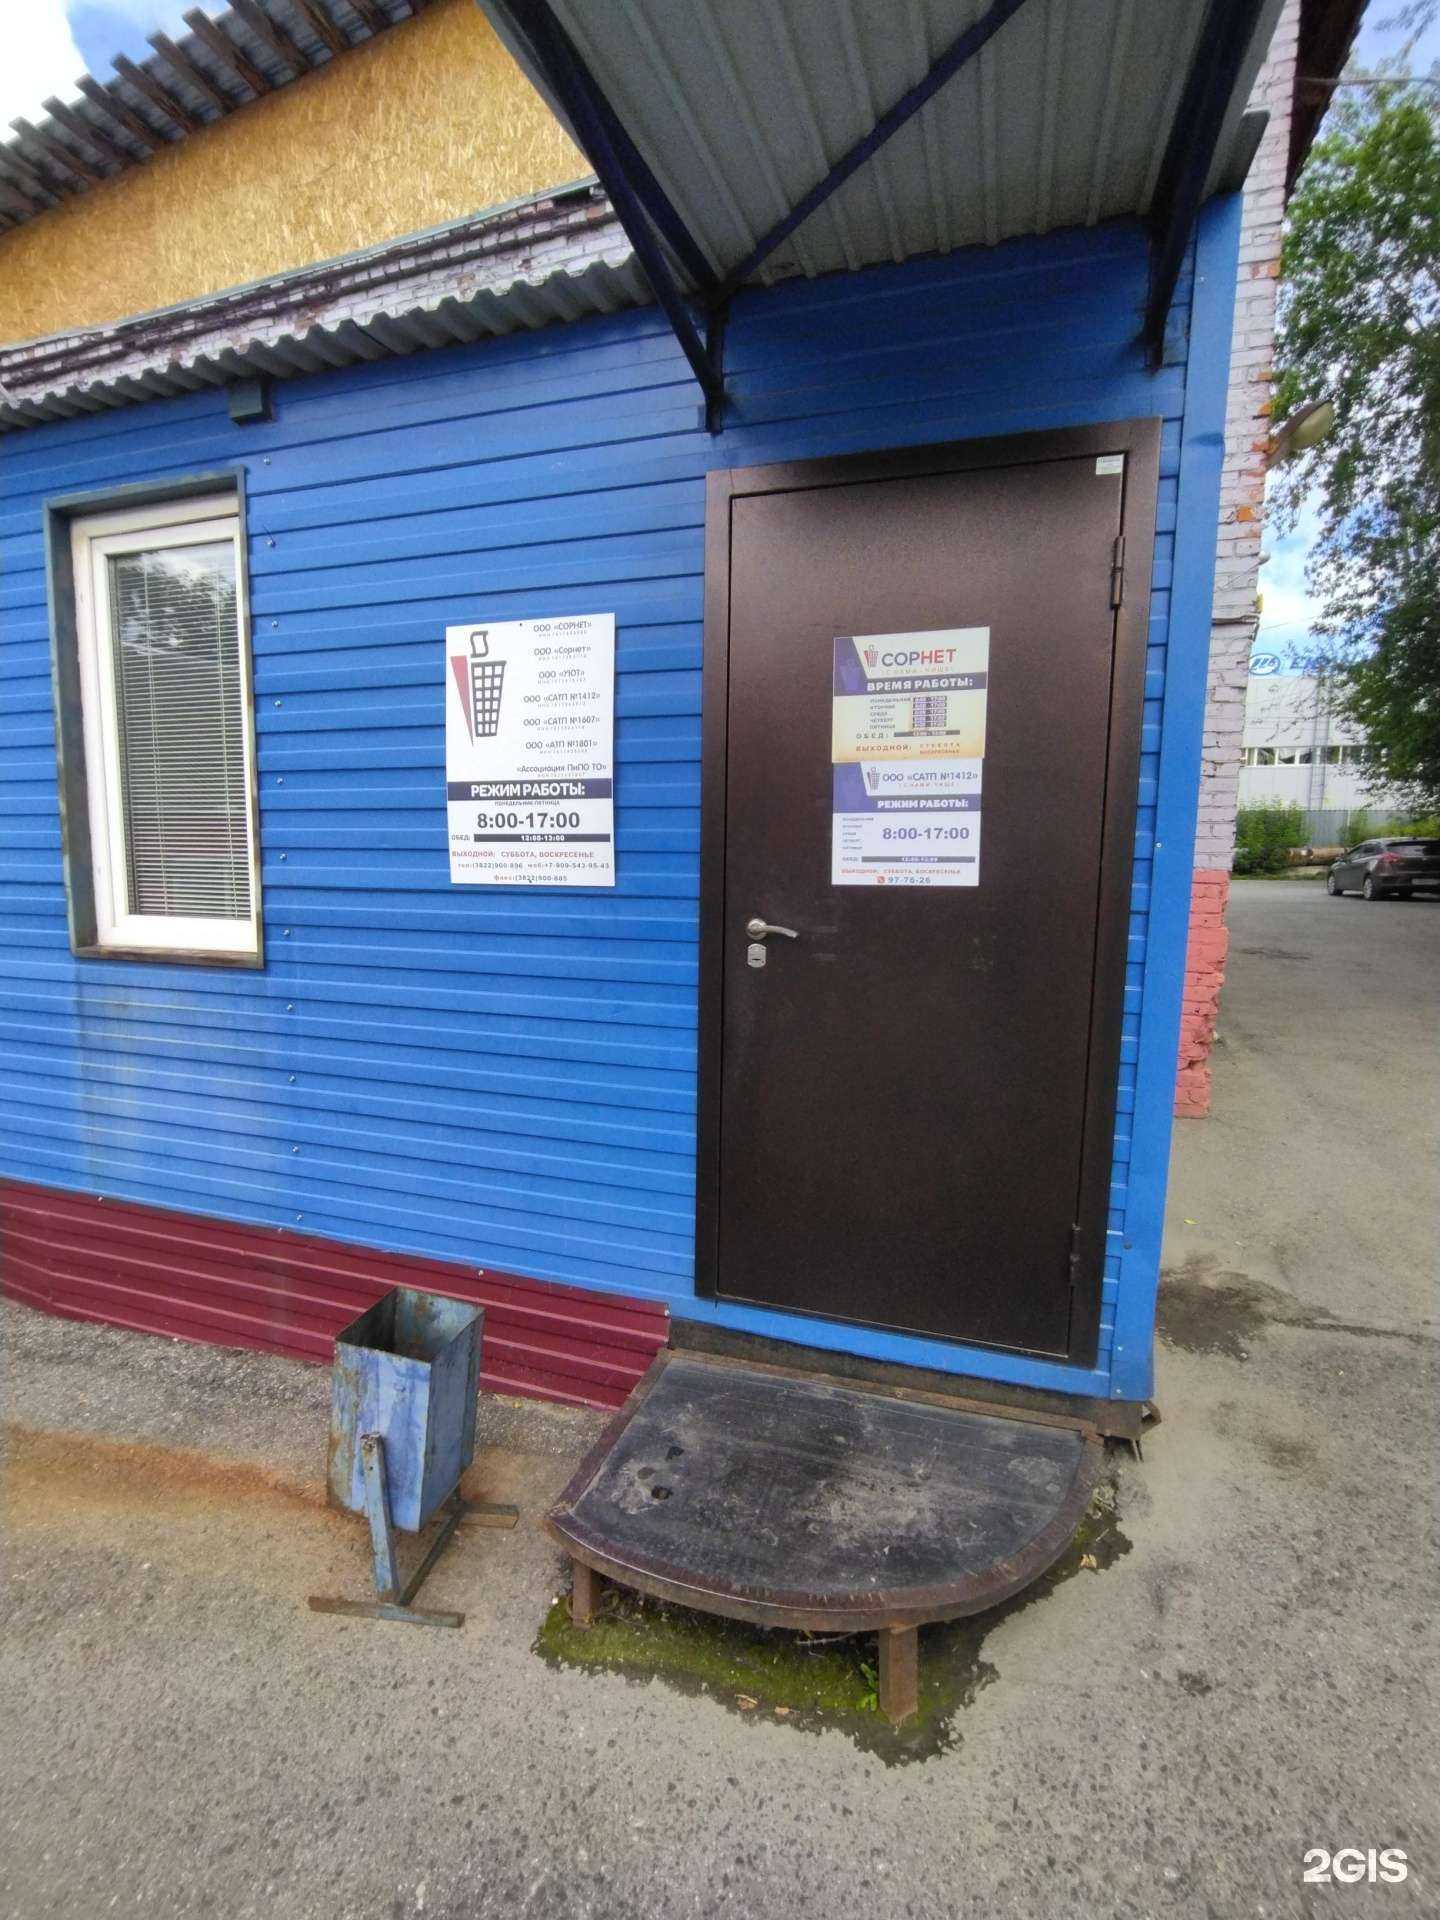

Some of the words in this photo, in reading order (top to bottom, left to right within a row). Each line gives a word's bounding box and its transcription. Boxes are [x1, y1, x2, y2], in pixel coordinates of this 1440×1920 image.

[534, 624, 551, 633] ООО
[554, 621, 592, 631] «СОРНЕТ»
[534, 648, 551, 656] ООО
[881, 648, 957, 667] СОРНЕТ
[539, 670, 556, 679] ООО
[866, 679, 912, 692] ВРЕМЯ
[914, 676, 974, 689] РАБОТЫ:
[524, 695, 541, 703] ООО
[523, 718, 541, 727] ООО
[525, 741, 543, 749] ООО
[882, 773, 904, 782] ООО
[907, 772, 937, 781] «САТП
[471, 784, 521, 798] РЕЖИМ
[523, 782, 586, 796] РАБОТЫ:
[877, 799, 919, 809] РЕЖИМ
[920, 798, 969, 808] РАБОТЫ:
[477, 812, 580, 829] 8:00-17:00
[882, 827, 970, 840] 8:00-17:00
